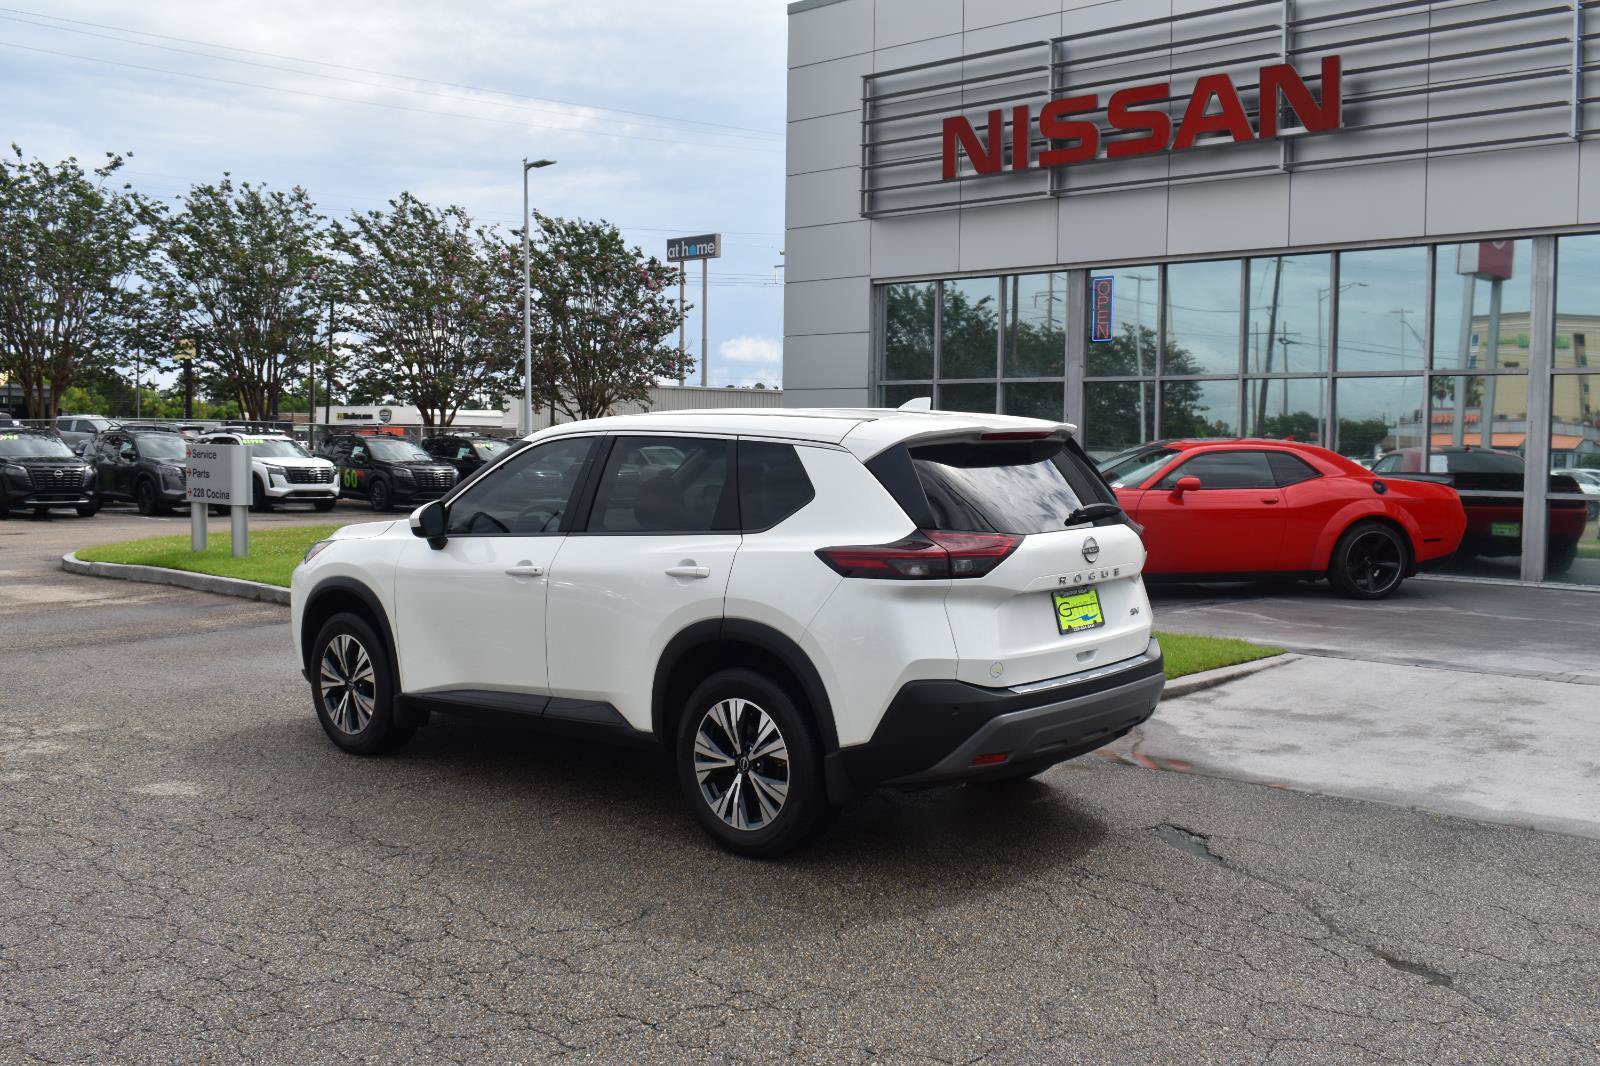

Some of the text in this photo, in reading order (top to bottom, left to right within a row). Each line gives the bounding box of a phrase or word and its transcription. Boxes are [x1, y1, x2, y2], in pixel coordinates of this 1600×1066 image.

[942, 54, 1342, 181] NISSAN
[667, 243, 680, 259] at
[1097, 281, 1110, 339] OPEN
[192, 449, 217, 460] Service
[192, 468, 210, 479] Parts
[193, 488, 230, 500] 228 Cocina
[1058, 567, 1120, 585] ROGUE
